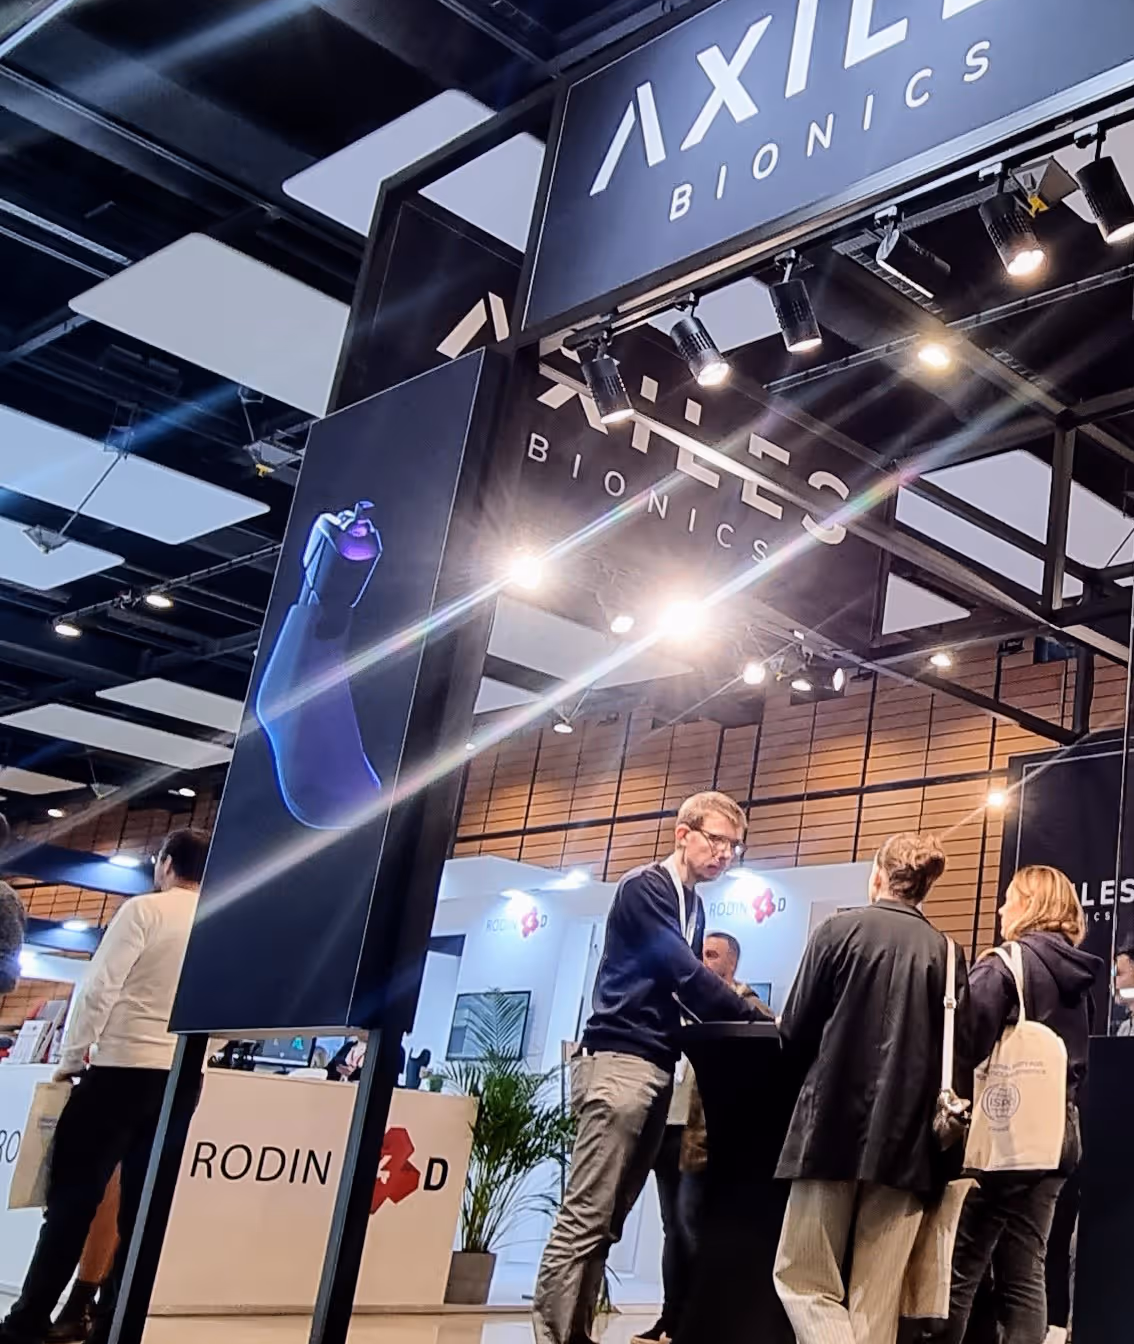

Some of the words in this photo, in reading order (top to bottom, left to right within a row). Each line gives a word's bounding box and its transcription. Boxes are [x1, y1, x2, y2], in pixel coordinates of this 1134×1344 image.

[667, 40, 992, 223] BIONICS
[527, 432, 769, 564] BIONICS
[189, 1141, 333, 1185] RODIN
